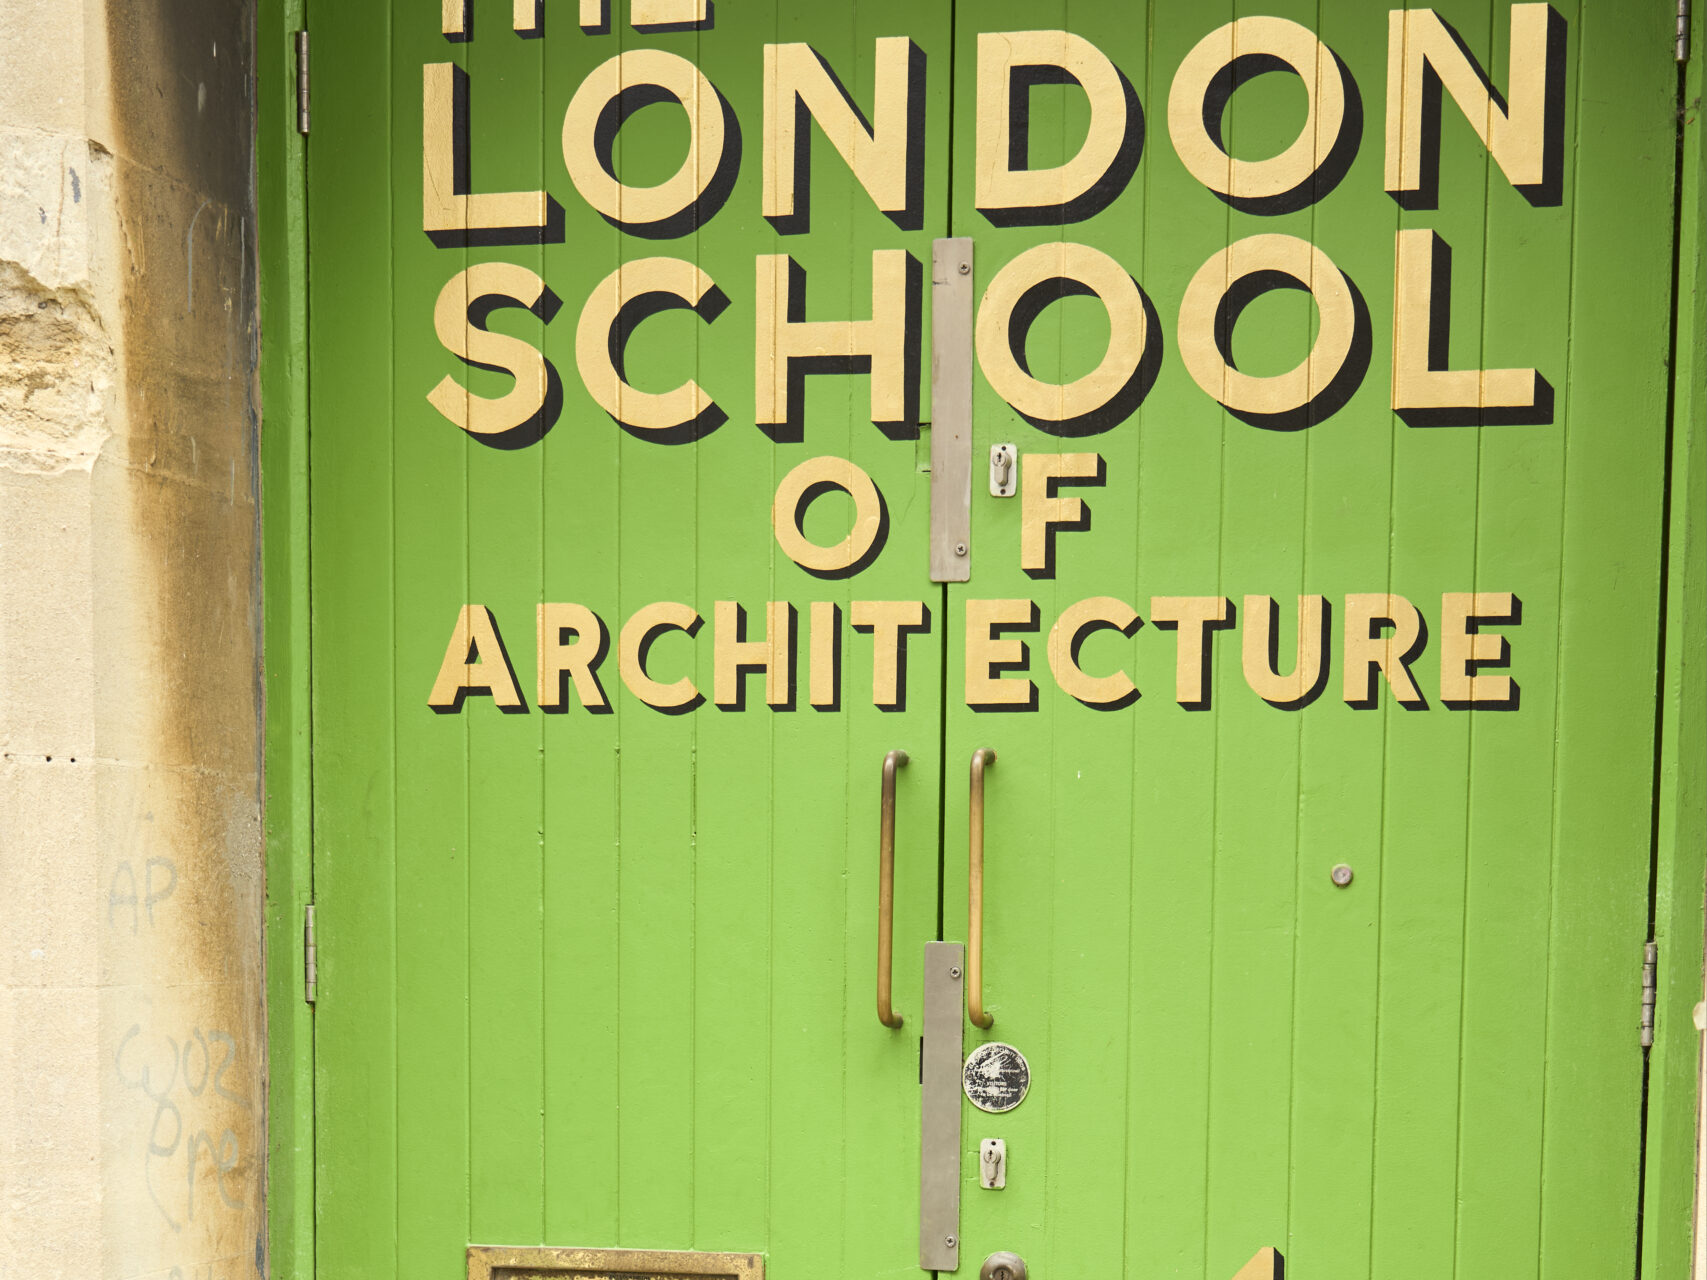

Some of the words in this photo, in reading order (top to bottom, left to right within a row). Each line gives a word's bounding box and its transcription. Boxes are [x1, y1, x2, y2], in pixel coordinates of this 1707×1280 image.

[423, 2, 1568, 249] LONDON
[426, 229, 1555, 451] SCHOOL
[427, 592, 1523, 715] ARCHITECTURE
